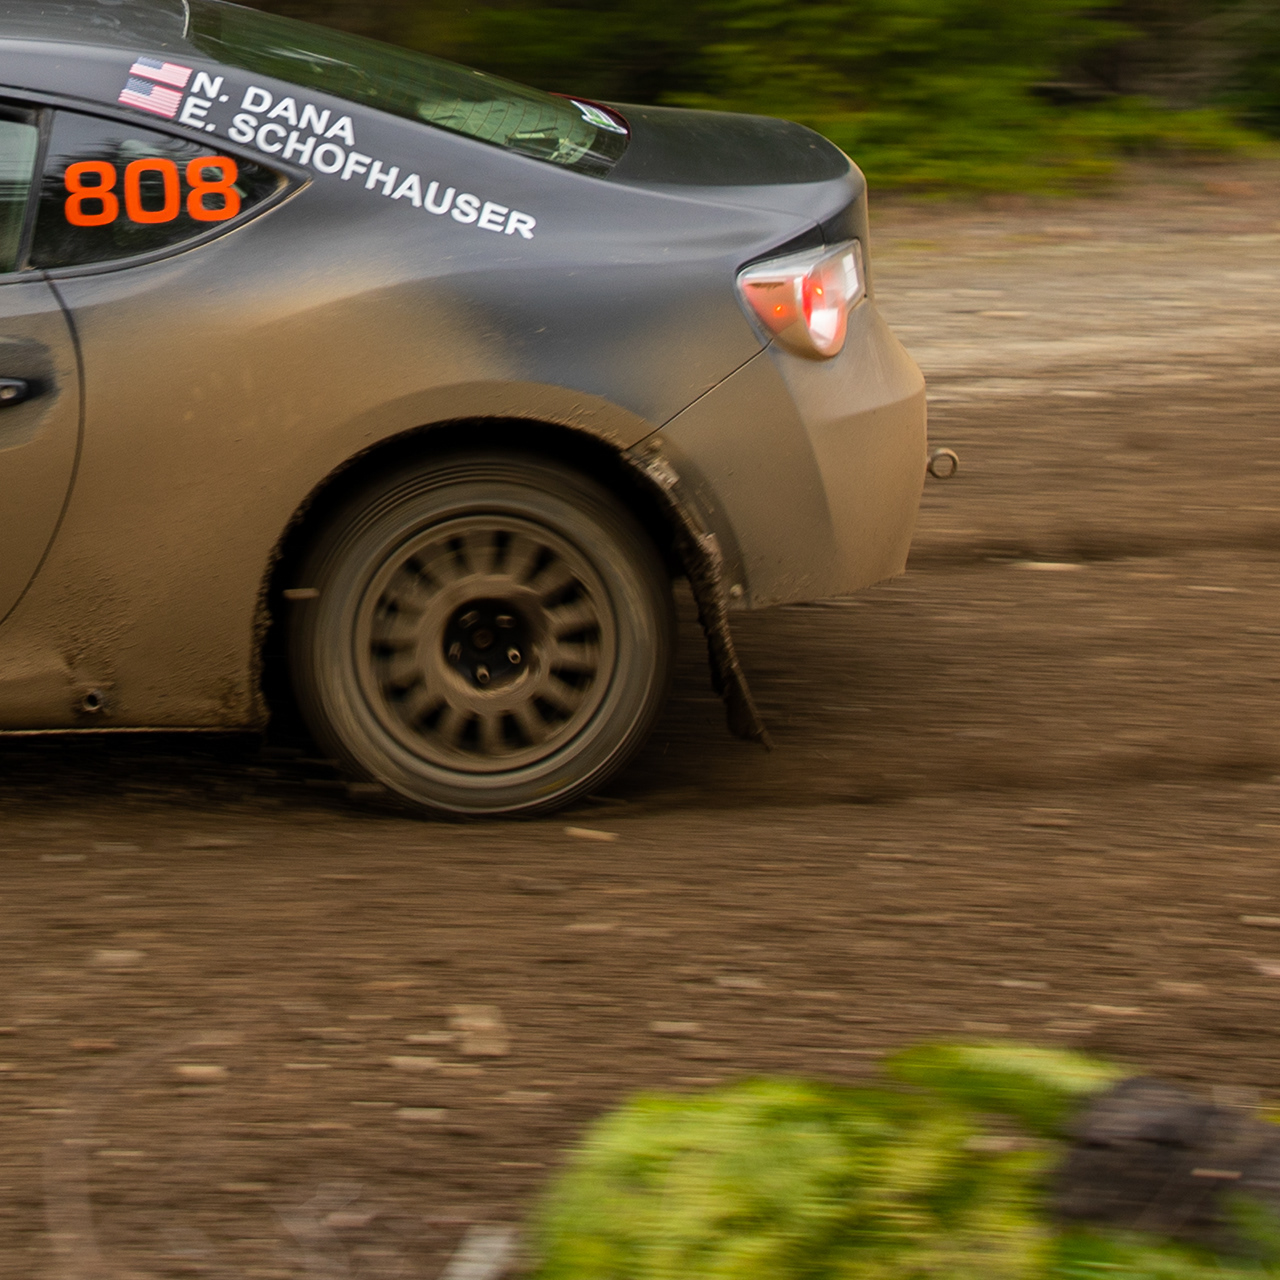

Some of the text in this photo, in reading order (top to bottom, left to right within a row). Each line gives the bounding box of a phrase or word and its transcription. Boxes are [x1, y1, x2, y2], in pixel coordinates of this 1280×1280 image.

[190, 71, 356, 146] N. DANA
[64, 155, 241, 227] 808
[178, 95, 537, 240] E. SCHOFHAUSER
